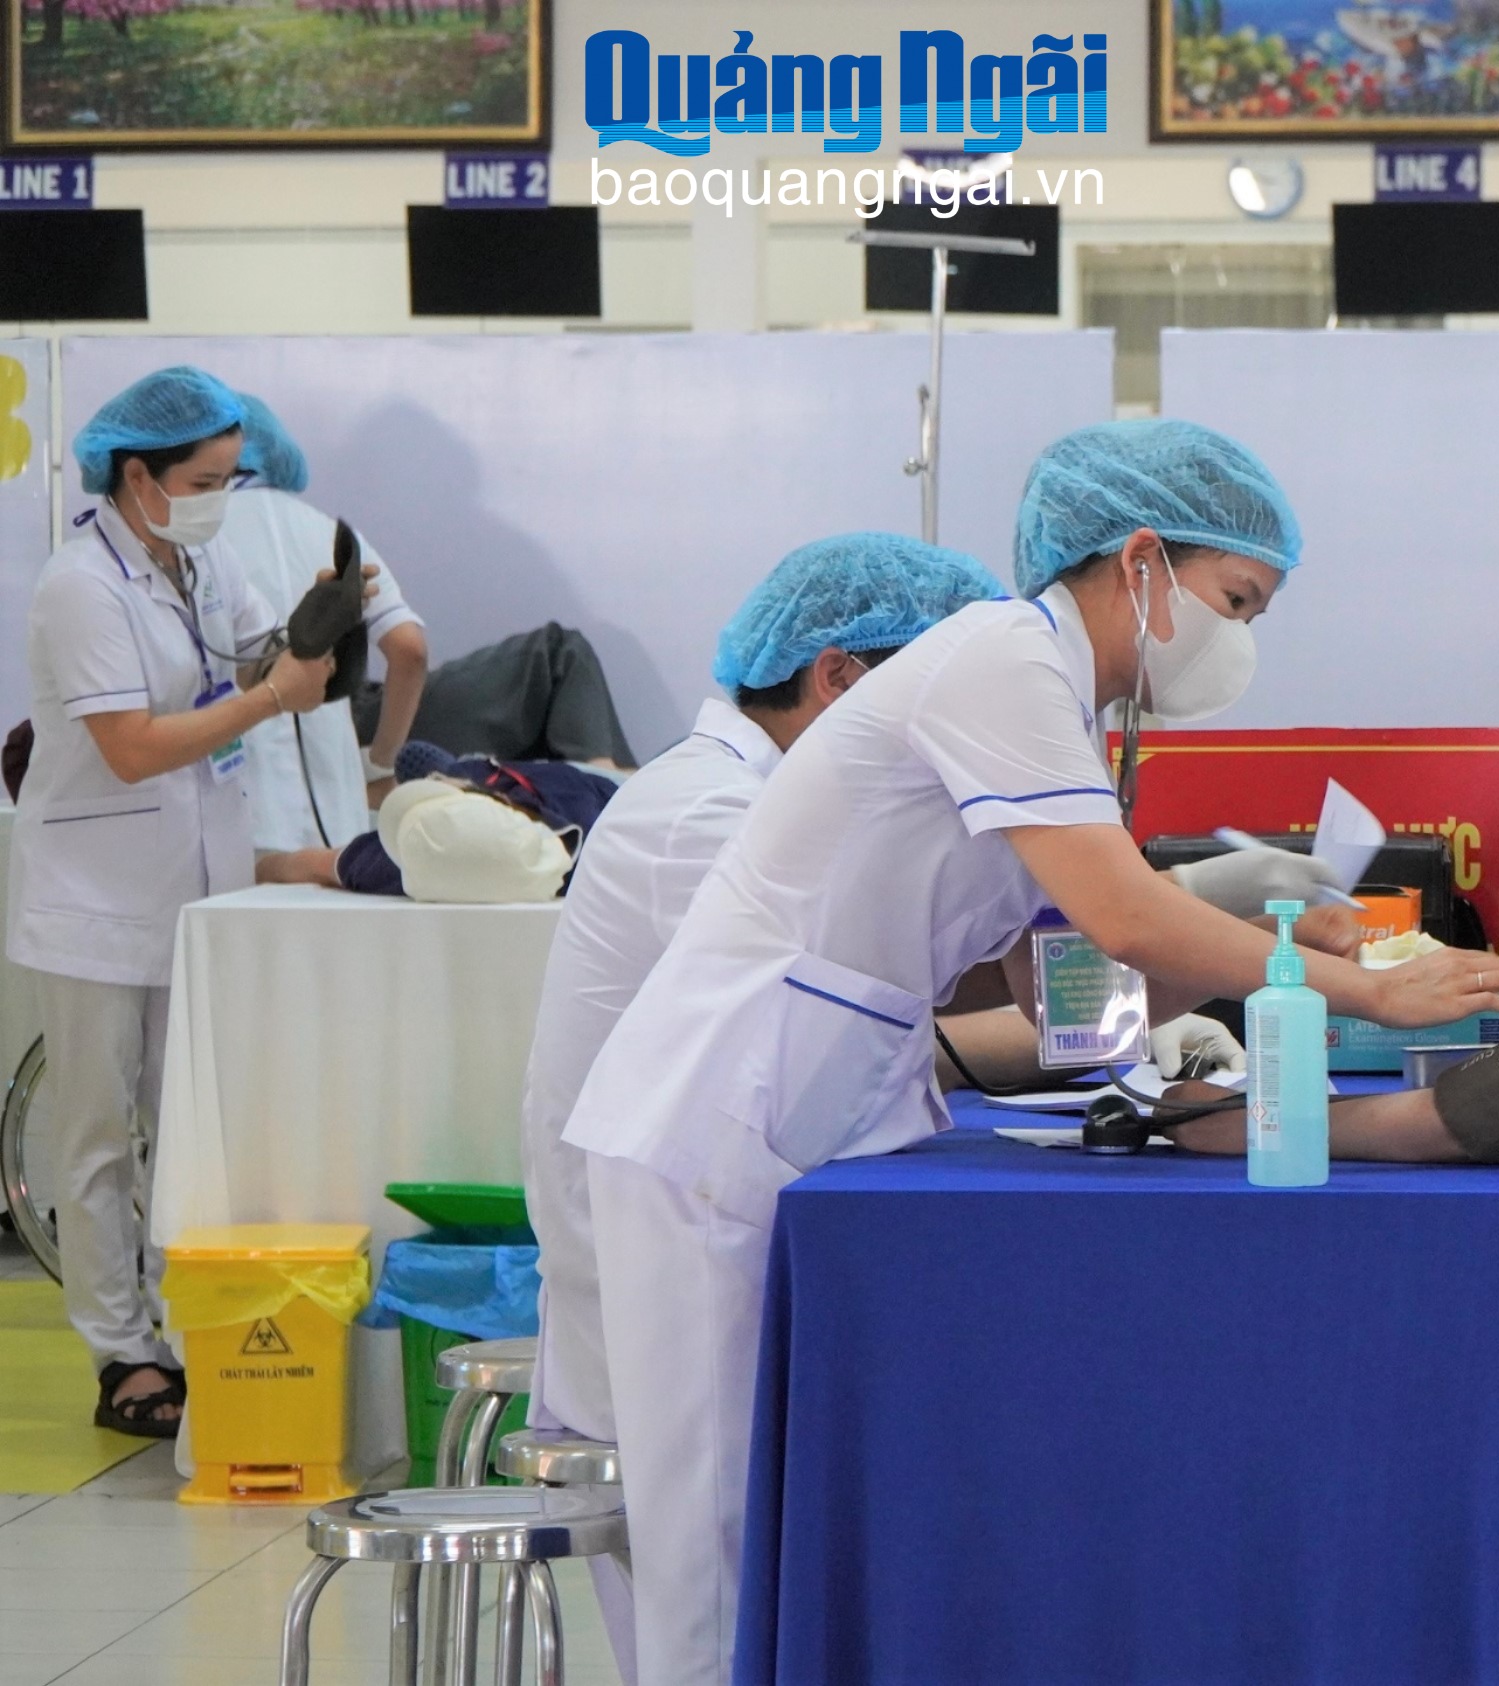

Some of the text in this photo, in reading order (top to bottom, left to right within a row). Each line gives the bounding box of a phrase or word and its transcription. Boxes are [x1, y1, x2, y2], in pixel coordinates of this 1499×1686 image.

[0, 164, 89, 199] LINE 1
[448, 161, 546, 198] LINE 2
[1376, 155, 1479, 192] LINE 4
